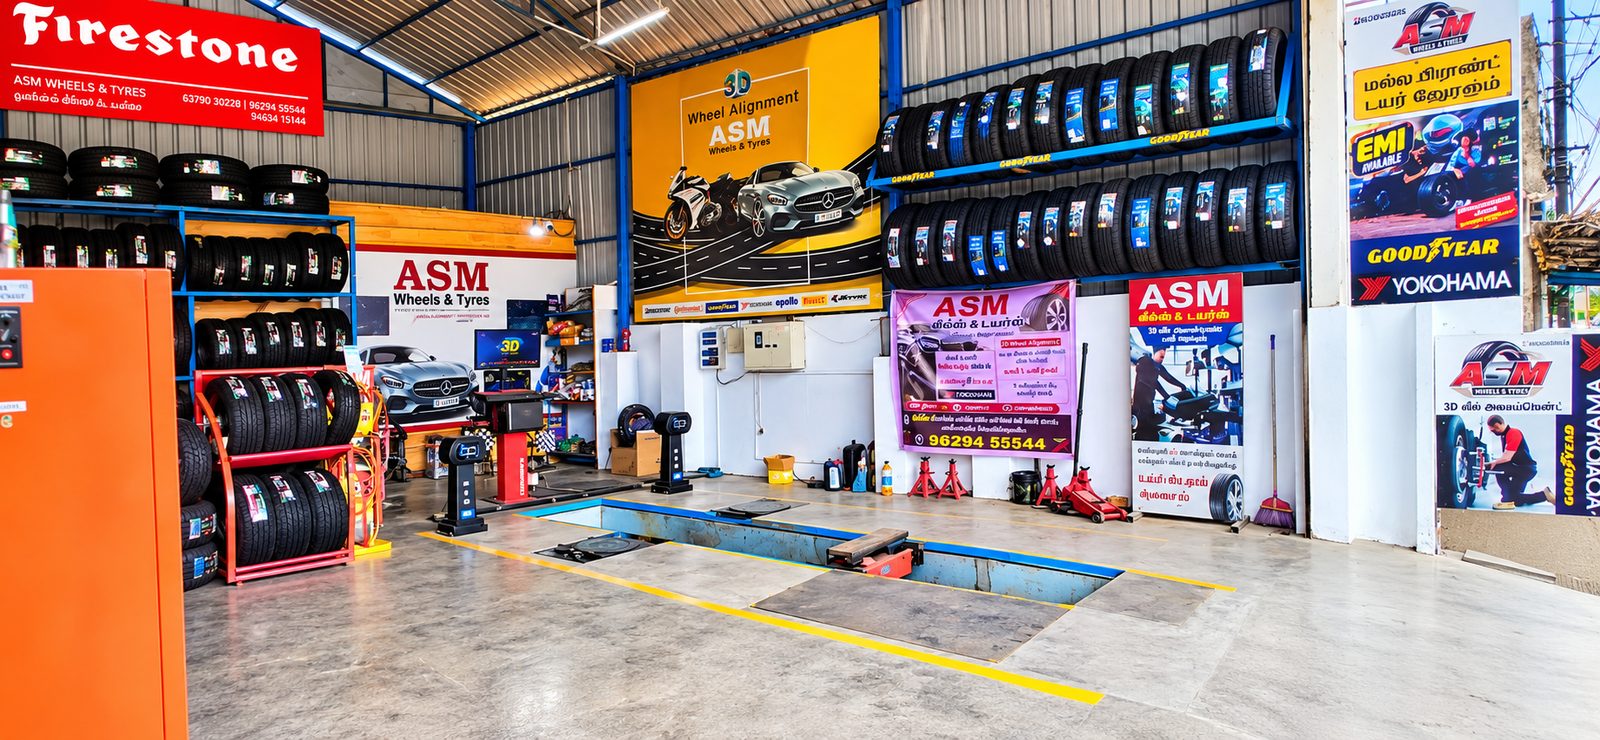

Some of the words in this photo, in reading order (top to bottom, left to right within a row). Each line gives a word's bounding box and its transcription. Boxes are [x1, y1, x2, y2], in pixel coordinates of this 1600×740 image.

[13, 2, 299, 72] Firestone
[1392, 12, 1476, 49] ASM
[14, 75, 41, 87] ASM
[45, 78, 95, 92] WHEELS
[99, 84, 107, 94] &
[110, 85, 146, 97] TYRES
[724, 68, 752, 98] 3D
[182, 94, 211, 105] 63790
[213, 98, 241, 108] 30228
[249, 101, 276, 111] 96294
[278, 104, 306, 114] 55544
[688, 106, 725, 125] Wheel
[729, 89, 799, 117] Alignment
[251, 112, 278, 122] 94634
[709, 115, 770, 147] ASM
[1150, 129, 1210, 145] GOODYEAR
[709, 144, 737, 155] Wheels
[739, 142, 745, 150] &
[748, 137, 771, 149] Tyres
[1357, 127, 1405, 162] EMI
[1367, 237, 1499, 264] GOODYEAR
[393, 259, 490, 291] ASM
[1392, 270, 1512, 296] YOKOHAMA
[394, 293, 440, 306] Wheels
[444, 294, 453, 306] &
[457, 293, 490, 308] Tyres
[933, 294, 1009, 317] ASM
[1139, 280, 1229, 310] ASM
[970, 320, 979, 329] &
[1175, 312, 1183, 321] &
[500, 339, 520, 353] 3D
[1449, 361, 1552, 387] ASM
[1444, 402, 1458, 411] 3D
[929, 434, 984, 448] 96294
[990, 435, 1046, 450] 55544
